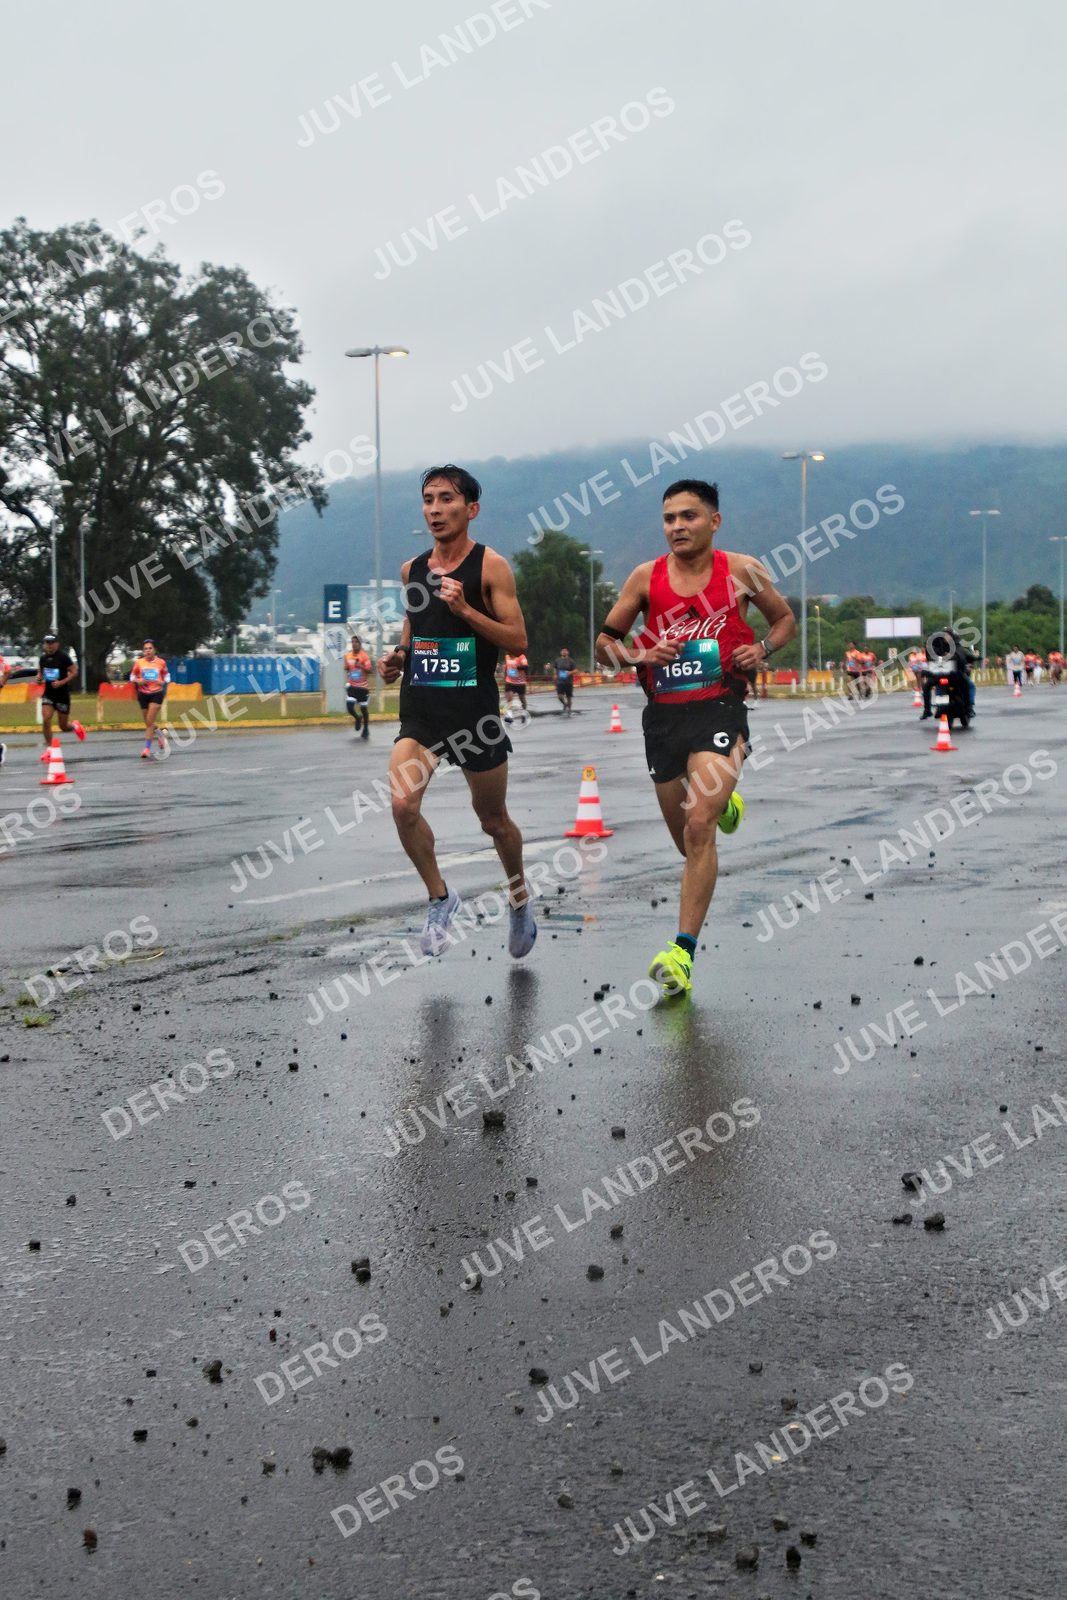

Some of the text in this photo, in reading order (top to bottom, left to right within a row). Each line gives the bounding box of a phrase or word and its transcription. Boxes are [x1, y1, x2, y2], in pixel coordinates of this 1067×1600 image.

[328, 600, 342, 618] E
[456, 641, 470, 652] 10K
[421, 658, 461, 673] 1735
[662, 660, 703, 678] 1662
